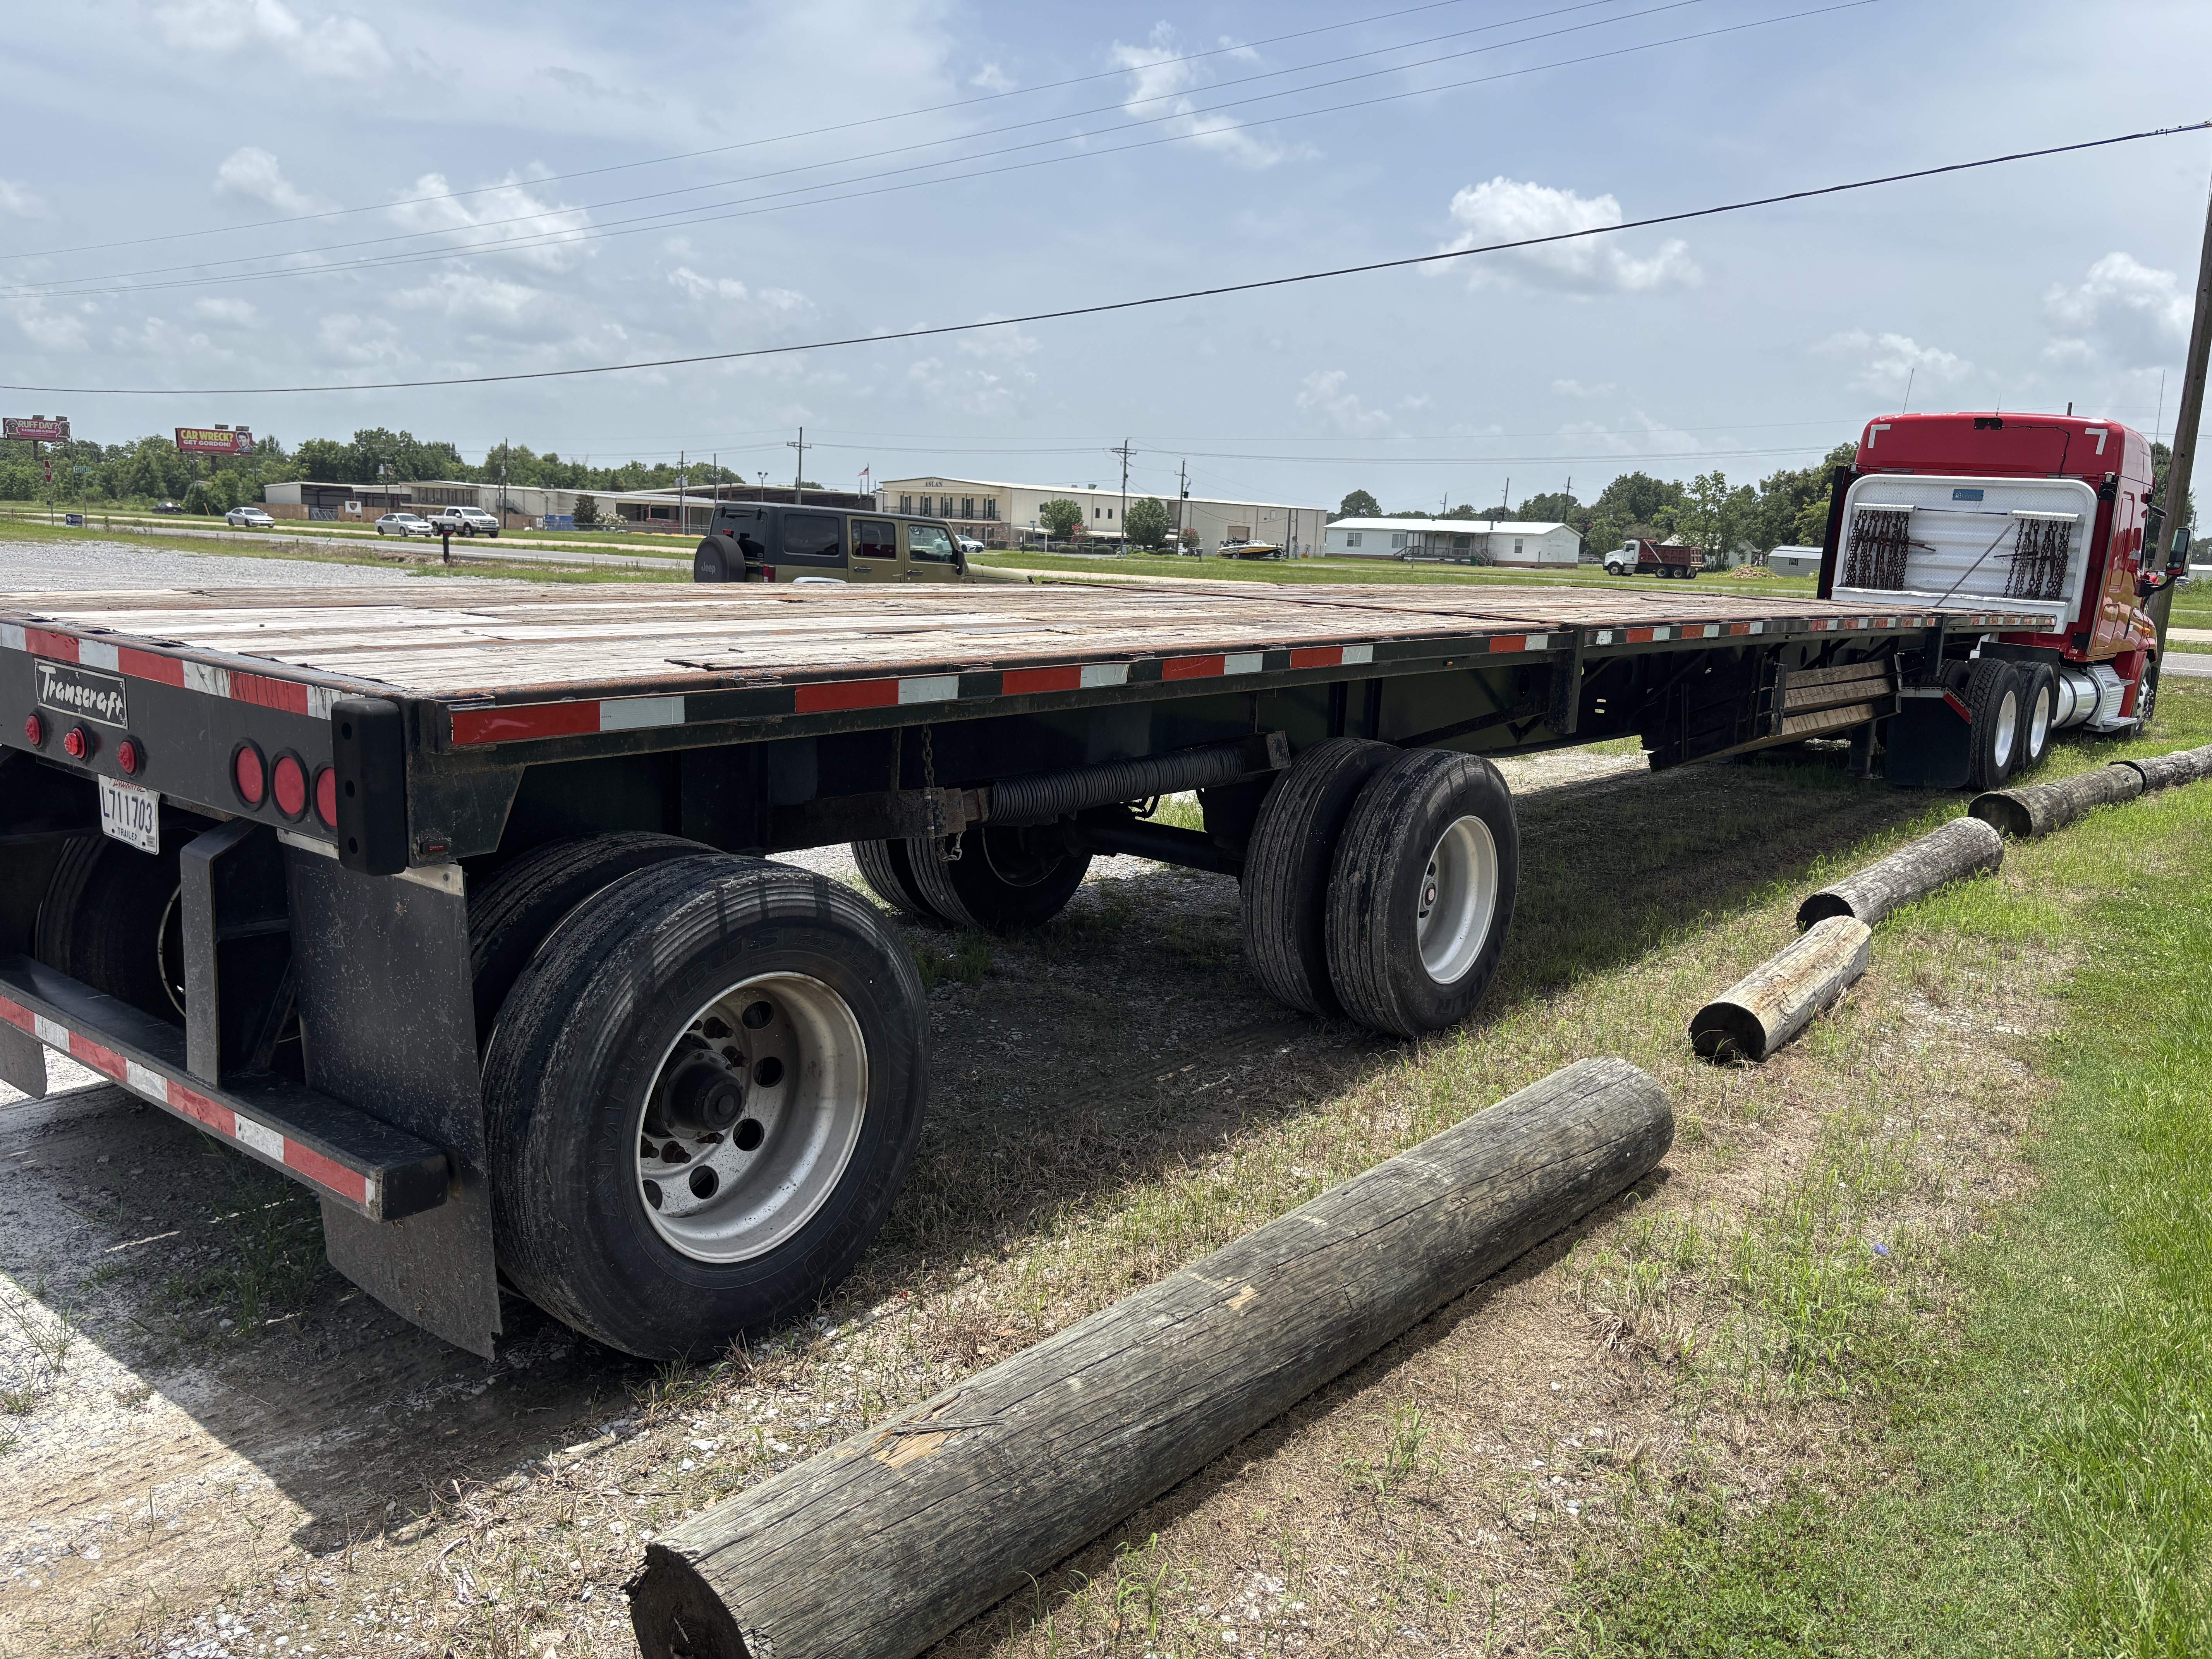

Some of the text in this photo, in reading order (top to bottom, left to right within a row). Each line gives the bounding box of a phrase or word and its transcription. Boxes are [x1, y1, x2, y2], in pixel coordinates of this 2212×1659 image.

[18, 420, 58, 429] RUFF DAY?
[181, 430, 234, 442] CAR WRECK?
[701, 562, 716, 574] Jeep
[39, 665, 124, 720] Transcraft
[101, 786, 152, 834] L711703
[118, 827, 137, 842] TRAILER
[1434, 913, 1511, 1015] VITOUR
